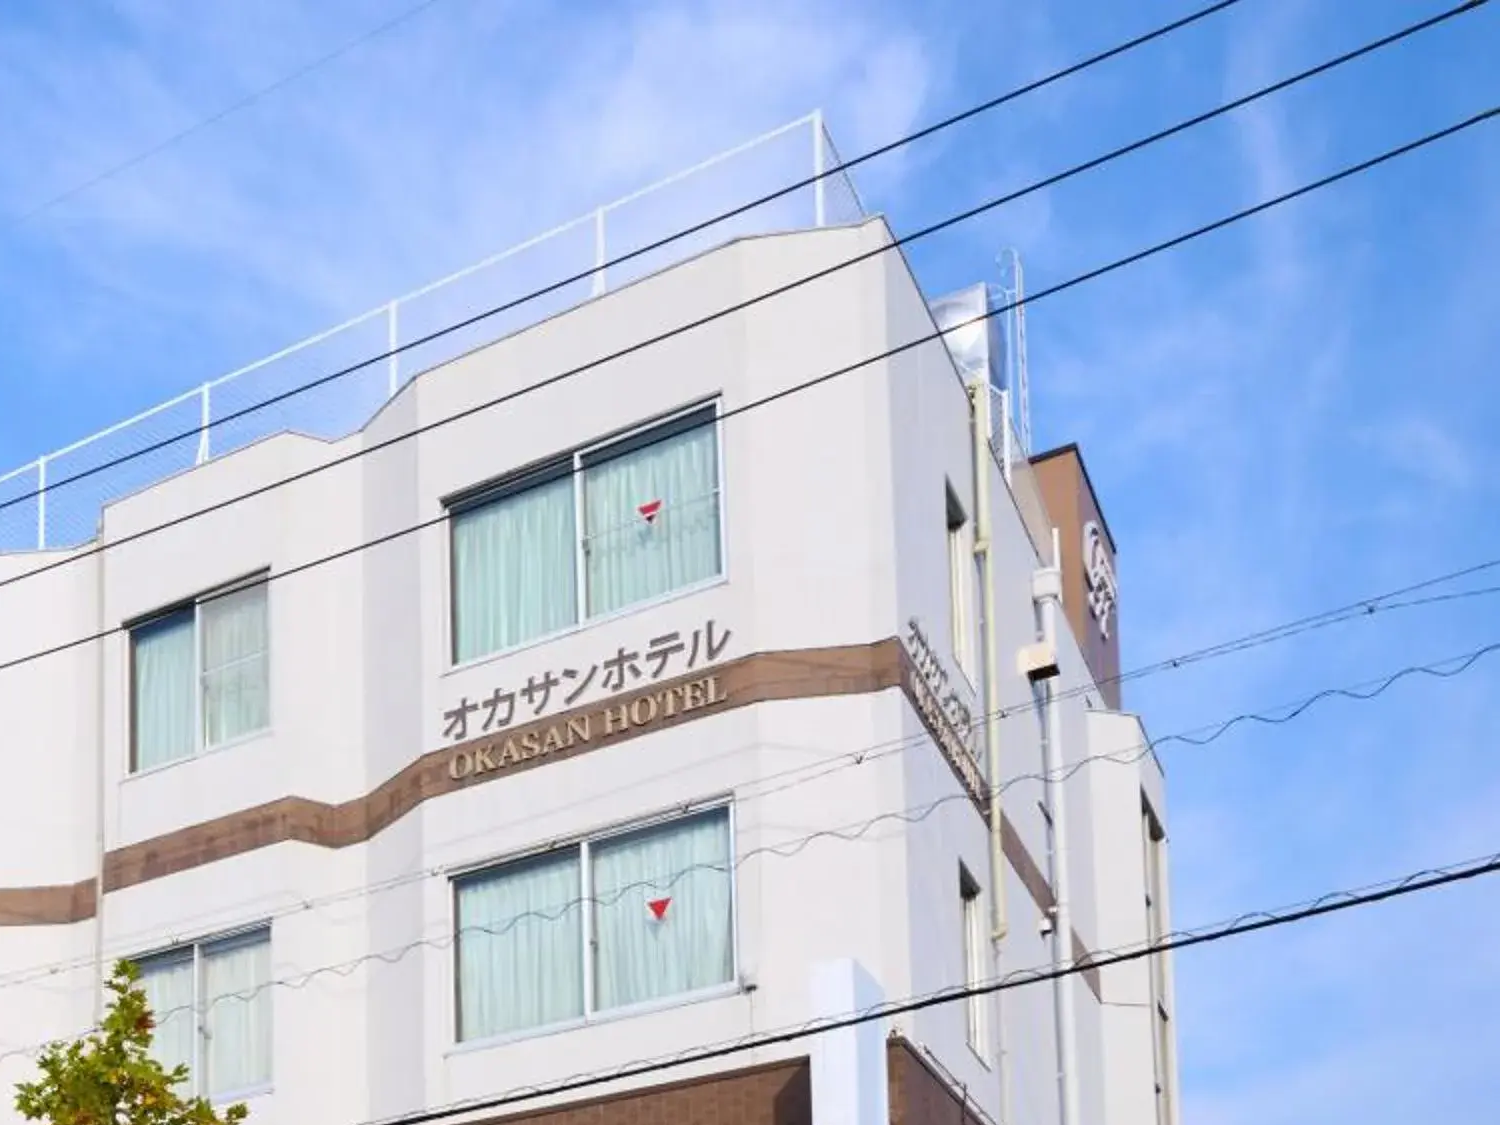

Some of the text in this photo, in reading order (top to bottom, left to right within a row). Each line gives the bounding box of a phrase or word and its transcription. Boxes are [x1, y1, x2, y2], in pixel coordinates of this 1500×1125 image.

[443, 619, 732, 741] オカサンホテル
[449, 675, 728, 780] OKASAN HOTEL
